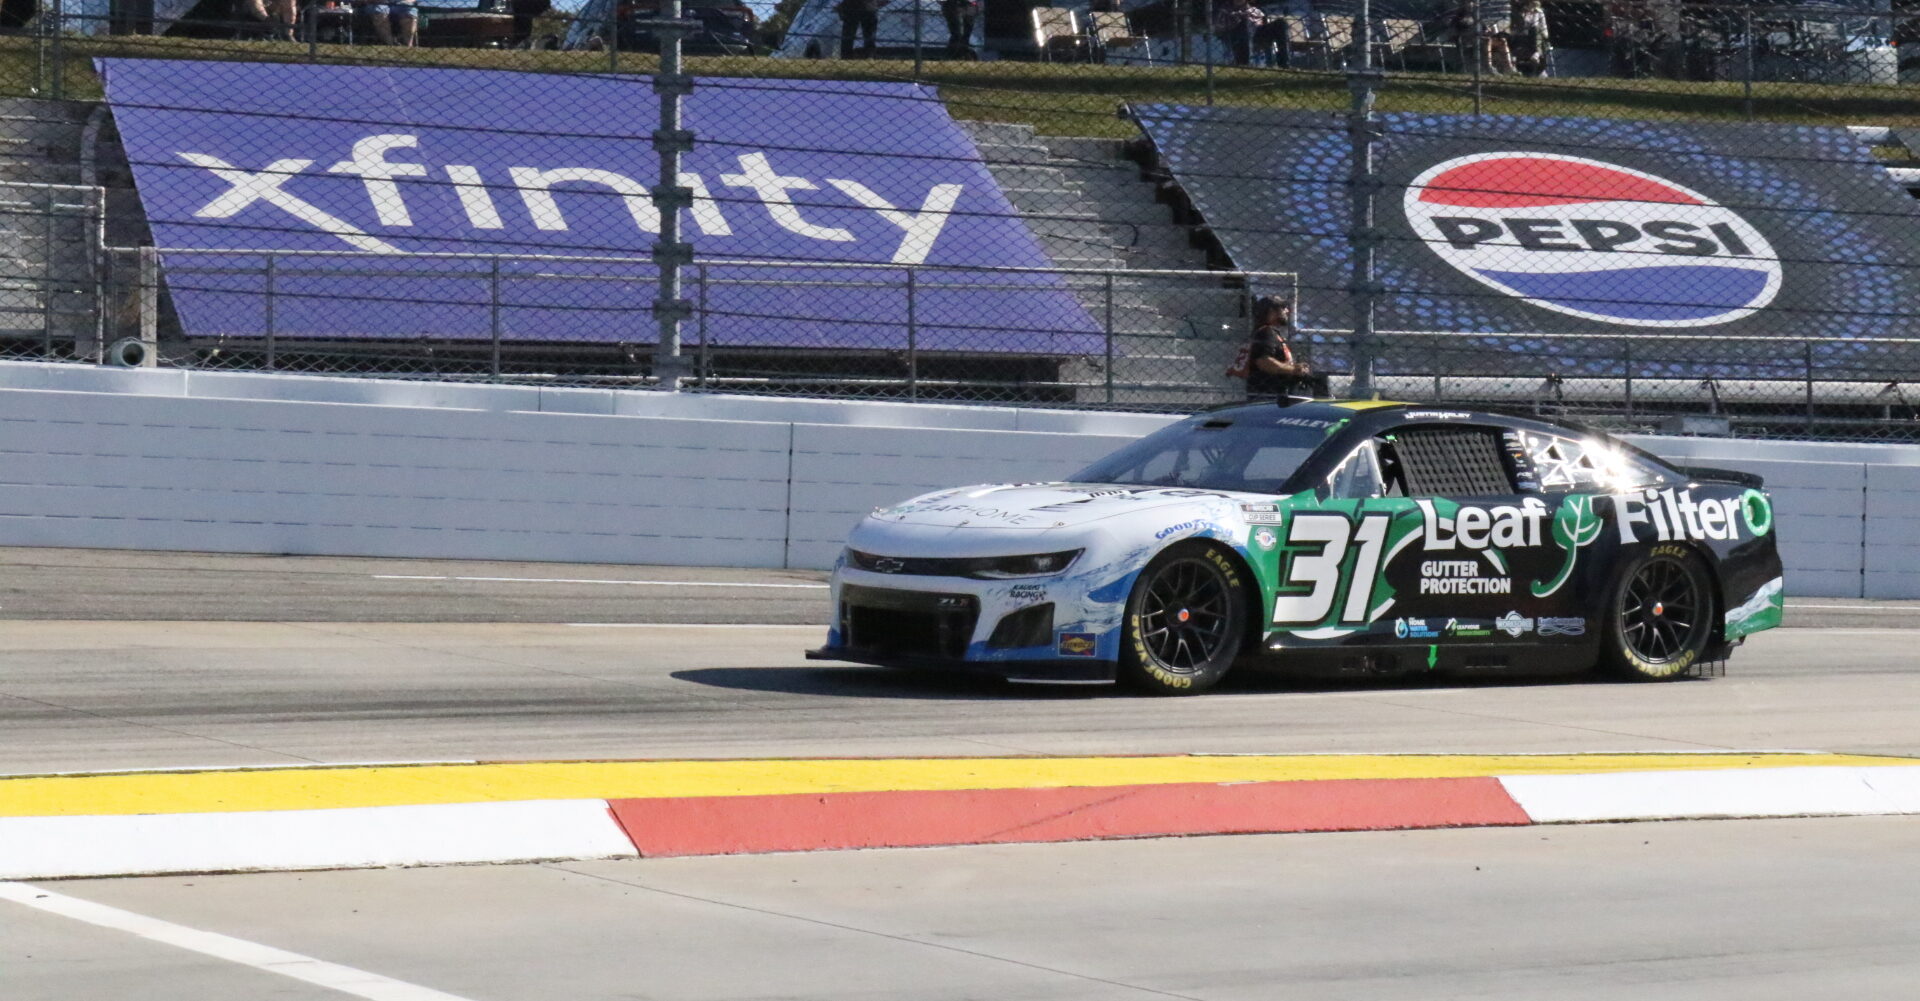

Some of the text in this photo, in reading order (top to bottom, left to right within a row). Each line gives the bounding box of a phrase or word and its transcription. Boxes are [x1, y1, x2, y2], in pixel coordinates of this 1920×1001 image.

[174, 134, 964, 267] xfinity
[1429, 215, 1755, 257] PEPSI
[1276, 417, 1335, 428] HALEY
[1415, 488, 1741, 550] Leaf Filter
[1205, 548, 1240, 588] EAGLE
[1271, 513, 1391, 625] 31
[1421, 561, 1478, 577] GUTTER
[1650, 545, 1688, 558] EAGLE
[1420, 578, 1512, 594] PROTECTION
